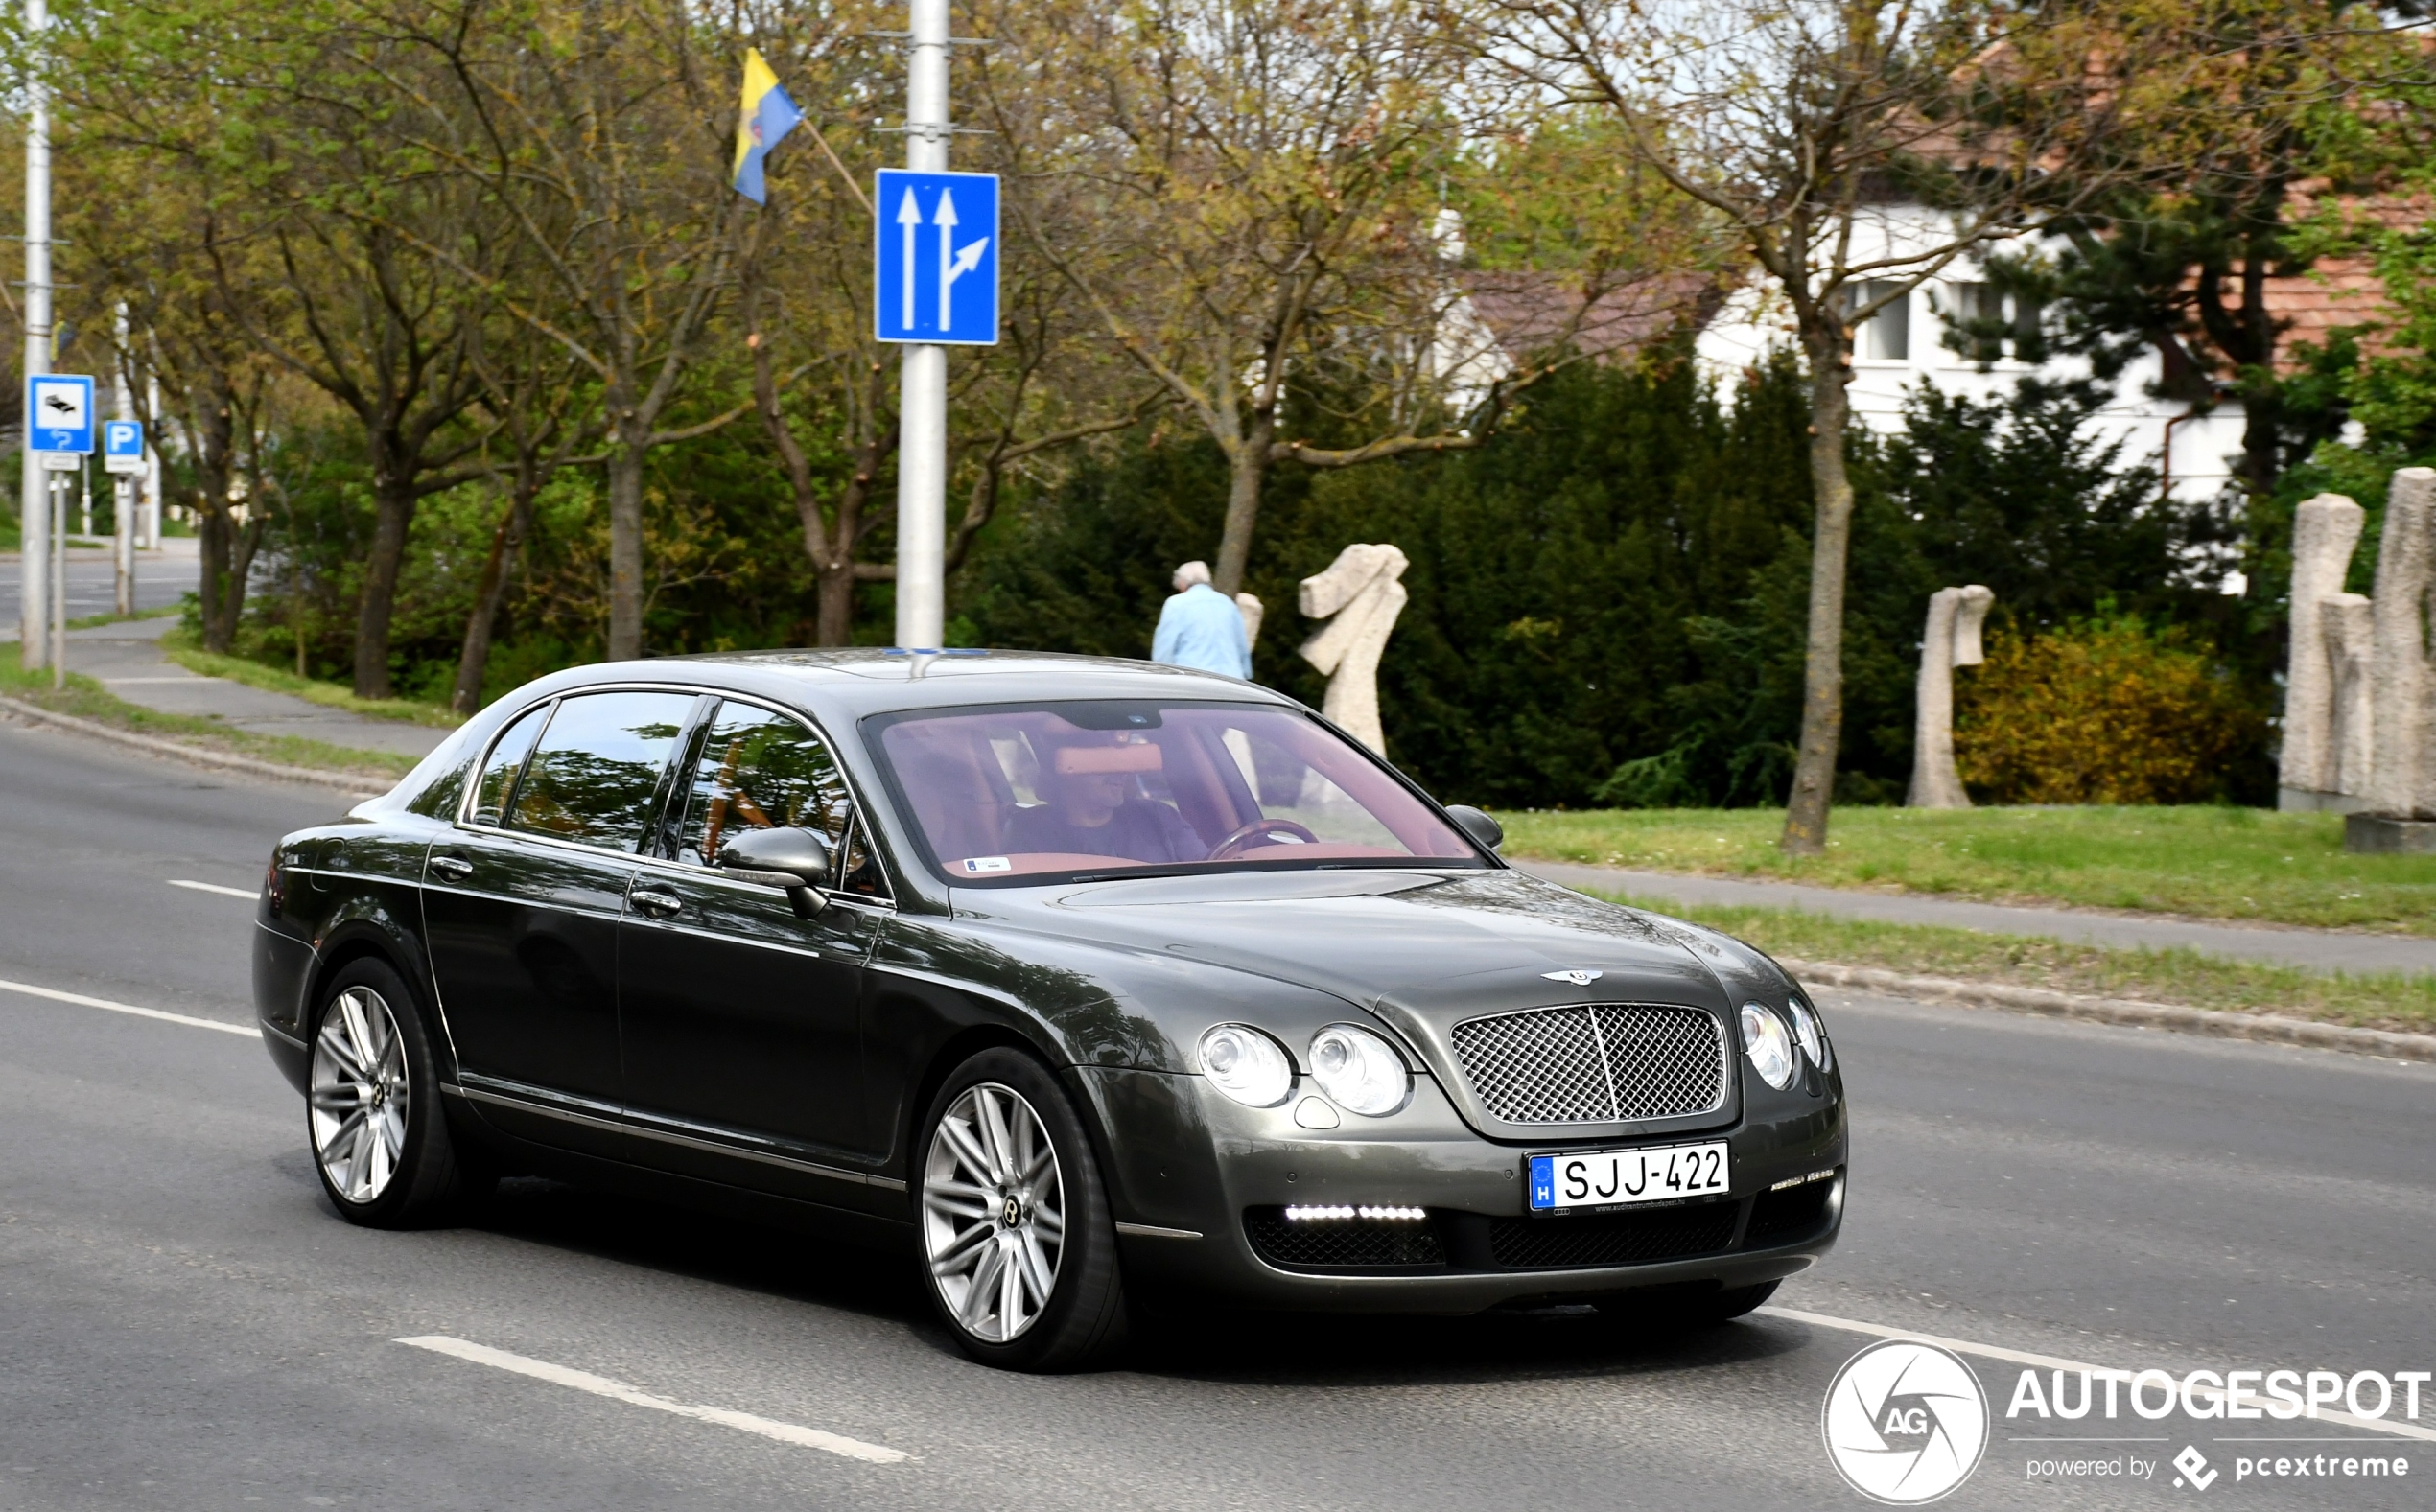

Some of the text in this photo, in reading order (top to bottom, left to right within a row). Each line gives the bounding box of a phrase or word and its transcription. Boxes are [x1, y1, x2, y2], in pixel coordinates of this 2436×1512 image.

[110, 425, 134, 452] P
[1565, 1150, 1721, 1199] SJJ-422
[1537, 1186, 1549, 1200] H
